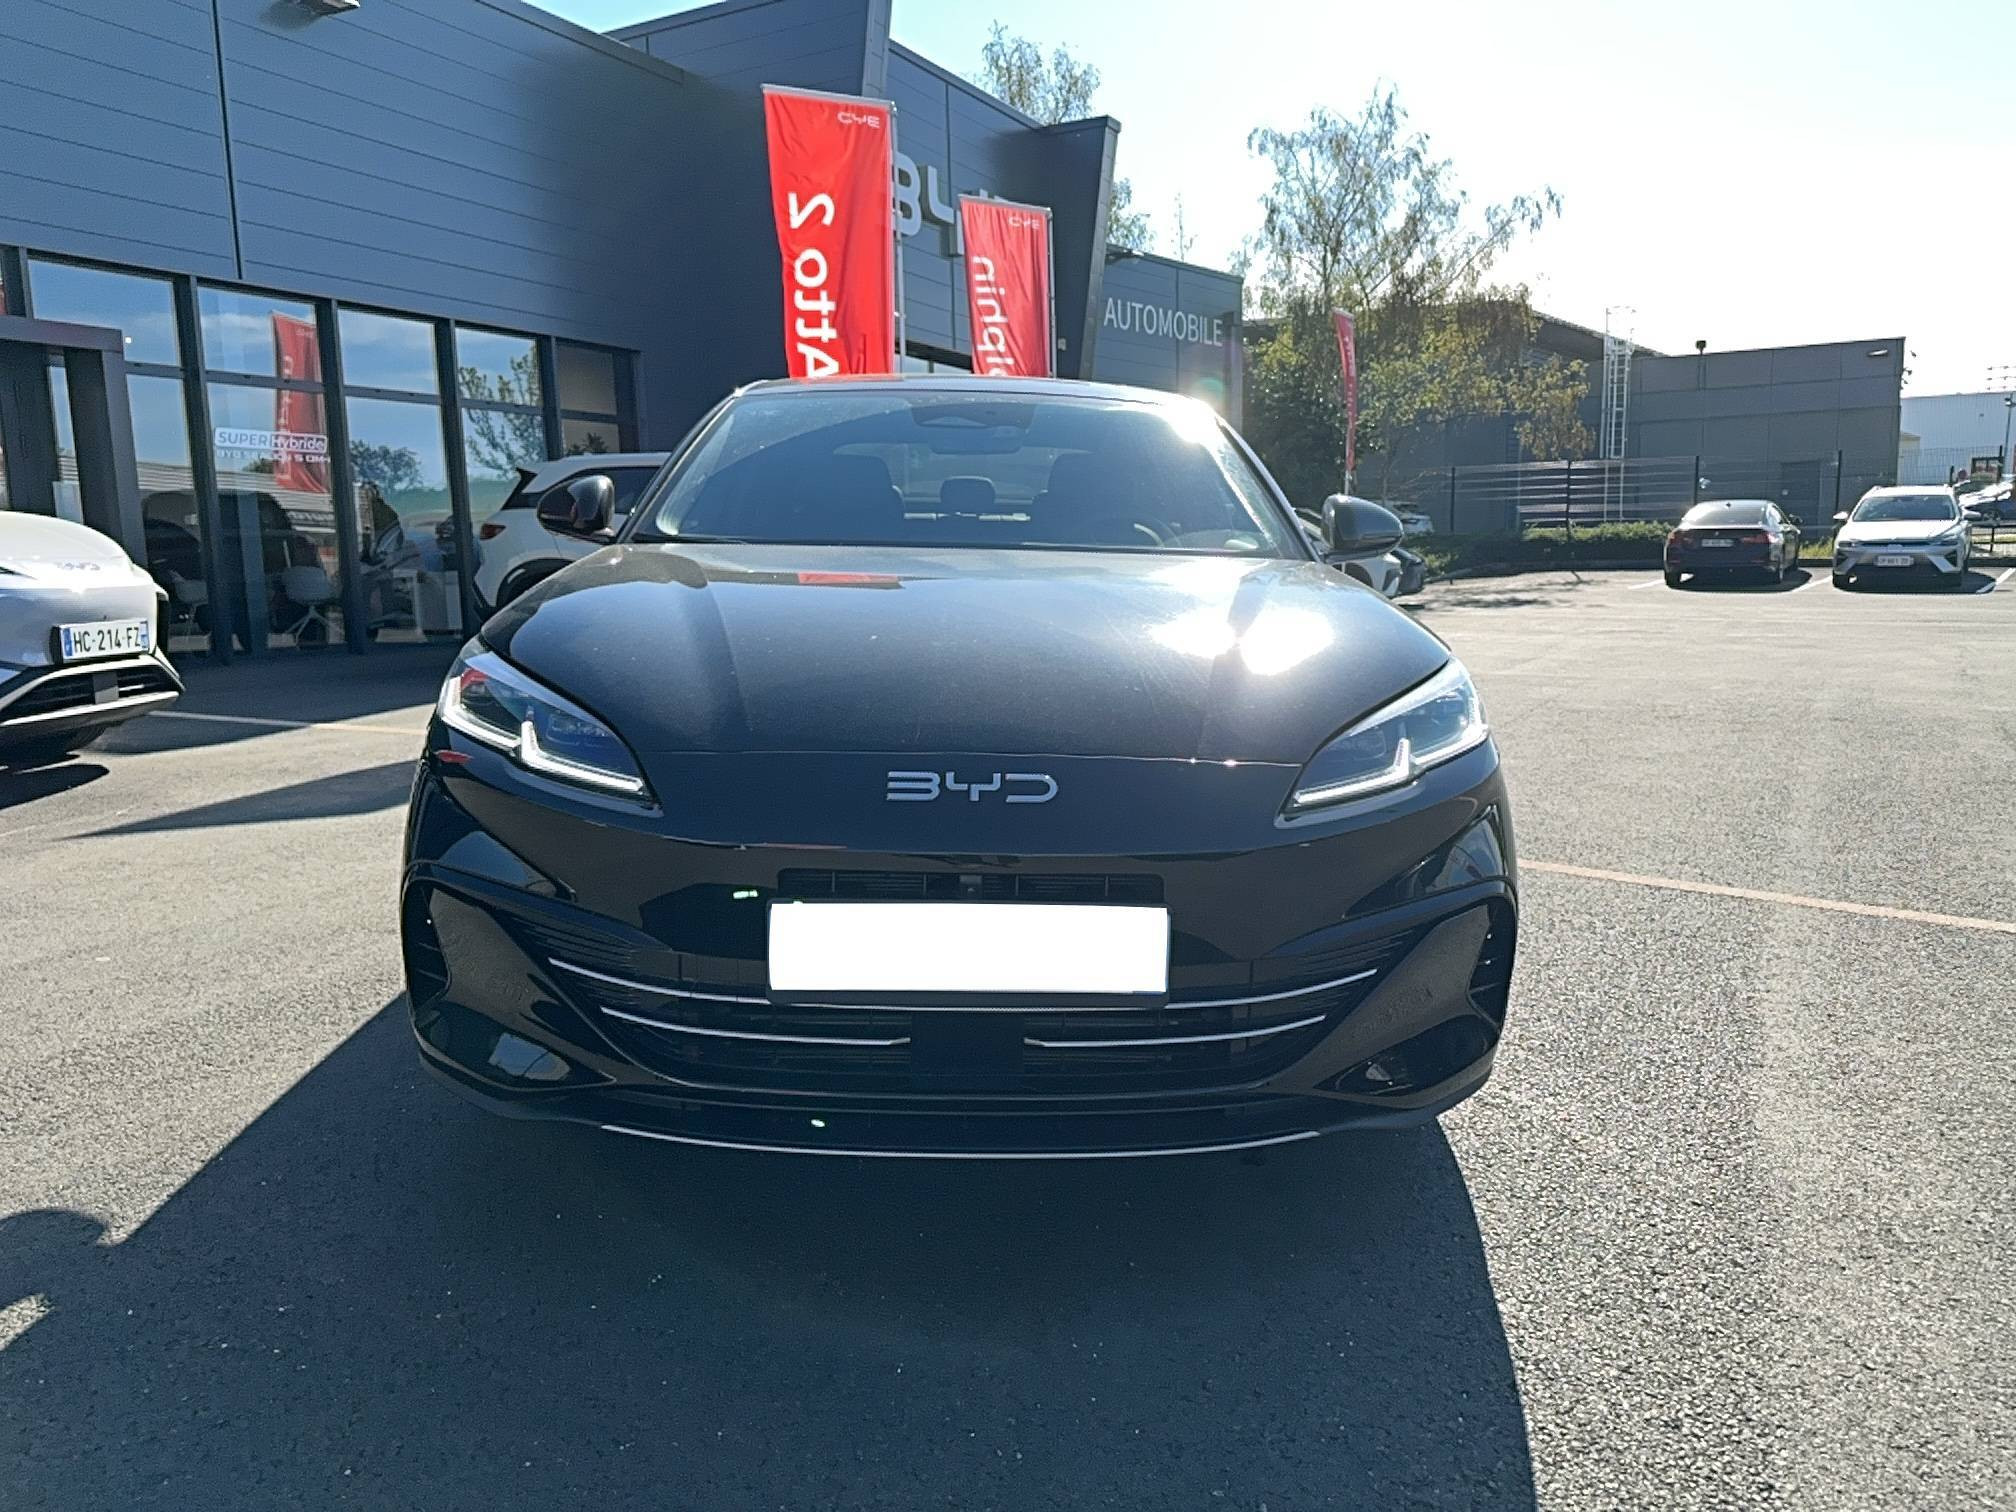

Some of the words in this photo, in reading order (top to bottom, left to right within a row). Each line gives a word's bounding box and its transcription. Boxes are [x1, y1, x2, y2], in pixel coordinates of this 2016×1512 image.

[1104, 297, 1223, 347] AUTOMOBILE
[219, 431, 267, 447] SUPER
[271, 433, 325, 450] Hybride
[73, 627, 141, 653] HC-214-FZ
[887, 771, 1058, 803] BYD
